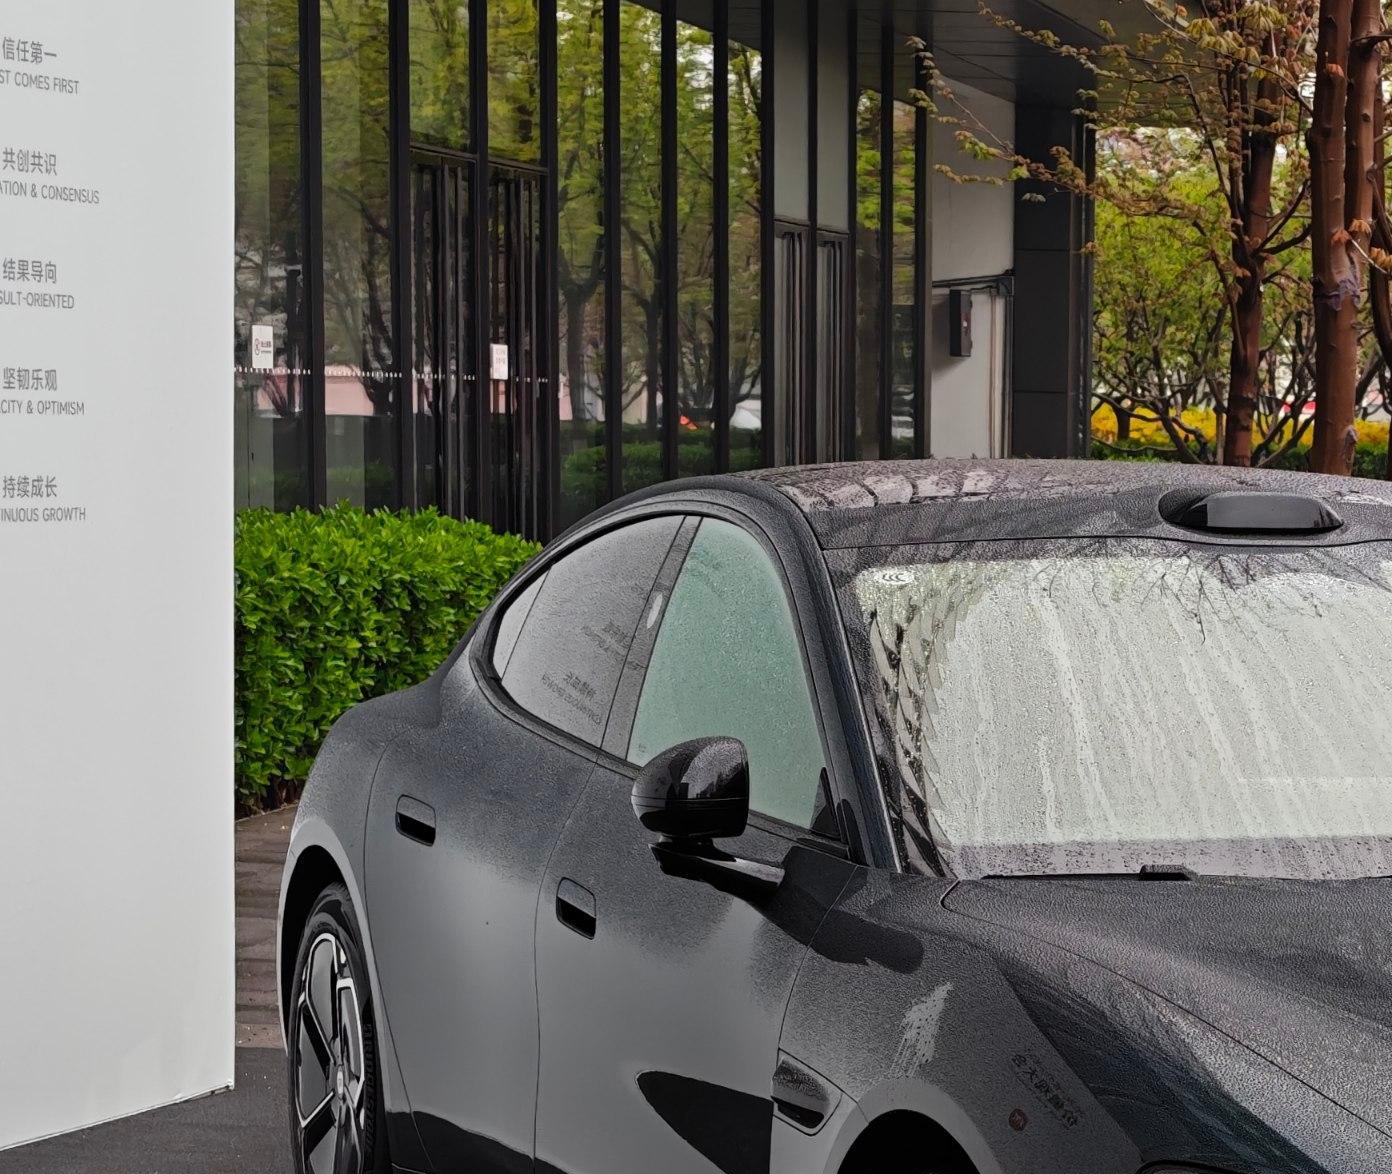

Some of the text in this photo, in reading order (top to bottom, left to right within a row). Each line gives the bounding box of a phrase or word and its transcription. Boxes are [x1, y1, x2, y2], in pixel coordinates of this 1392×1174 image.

[2, 36, 57, 64] 信任第一
[14, 72, 50, 91] COMES
[53, 77, 80, 95] FIRST
[2, 148, 57, 176] 共创共识
[30, 183, 37, 198] &
[41, 184, 100, 204] CONSENSUS
[2, 258, 57, 284] 结果导向
[3, 367, 57, 391] 坚韧乐观
[26, 399, 34, 414] &
[37, 400, 85, 415] OPTIMISM
[2, 475, 57, 499] 持续成长
[42, 507, 86, 522] GROWTH
